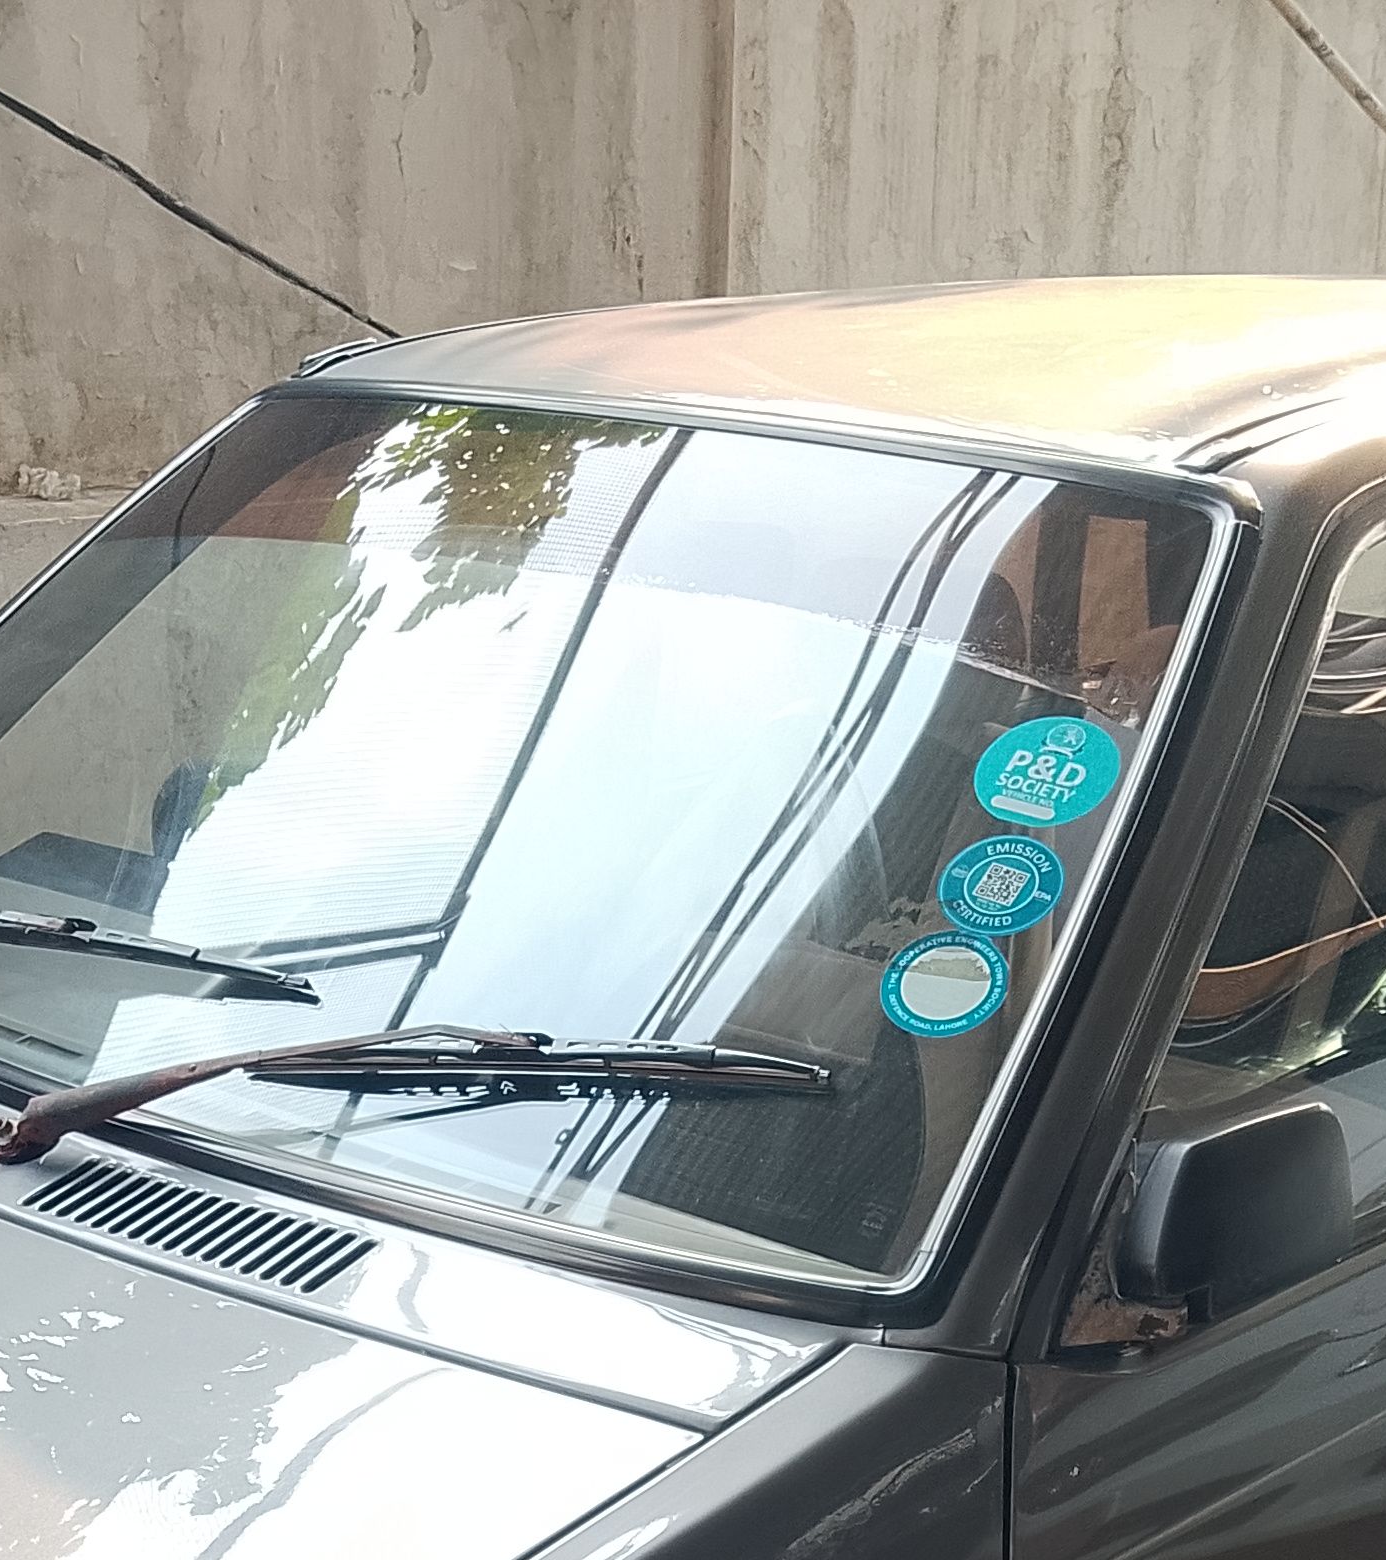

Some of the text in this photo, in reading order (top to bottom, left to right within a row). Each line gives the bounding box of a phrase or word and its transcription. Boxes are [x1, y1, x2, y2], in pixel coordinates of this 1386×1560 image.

[1004, 750, 1087, 787] P&D
[995, 772, 1077, 803] SOCIETY
[986, 842, 1053, 873] EMISSION
[1034, 890, 1052, 901] EPA
[953, 899, 1012, 927] CERTIFIED
[955, 936, 998, 963] ENGINEERS
[888, 972, 899, 990] THE
[994, 961, 1004, 986] TOWN
[888, 994, 910, 1021] DEFENCE
[933, 1019, 969, 1031] LAHORE
[973, 987, 1002, 1020] SOCIETY
